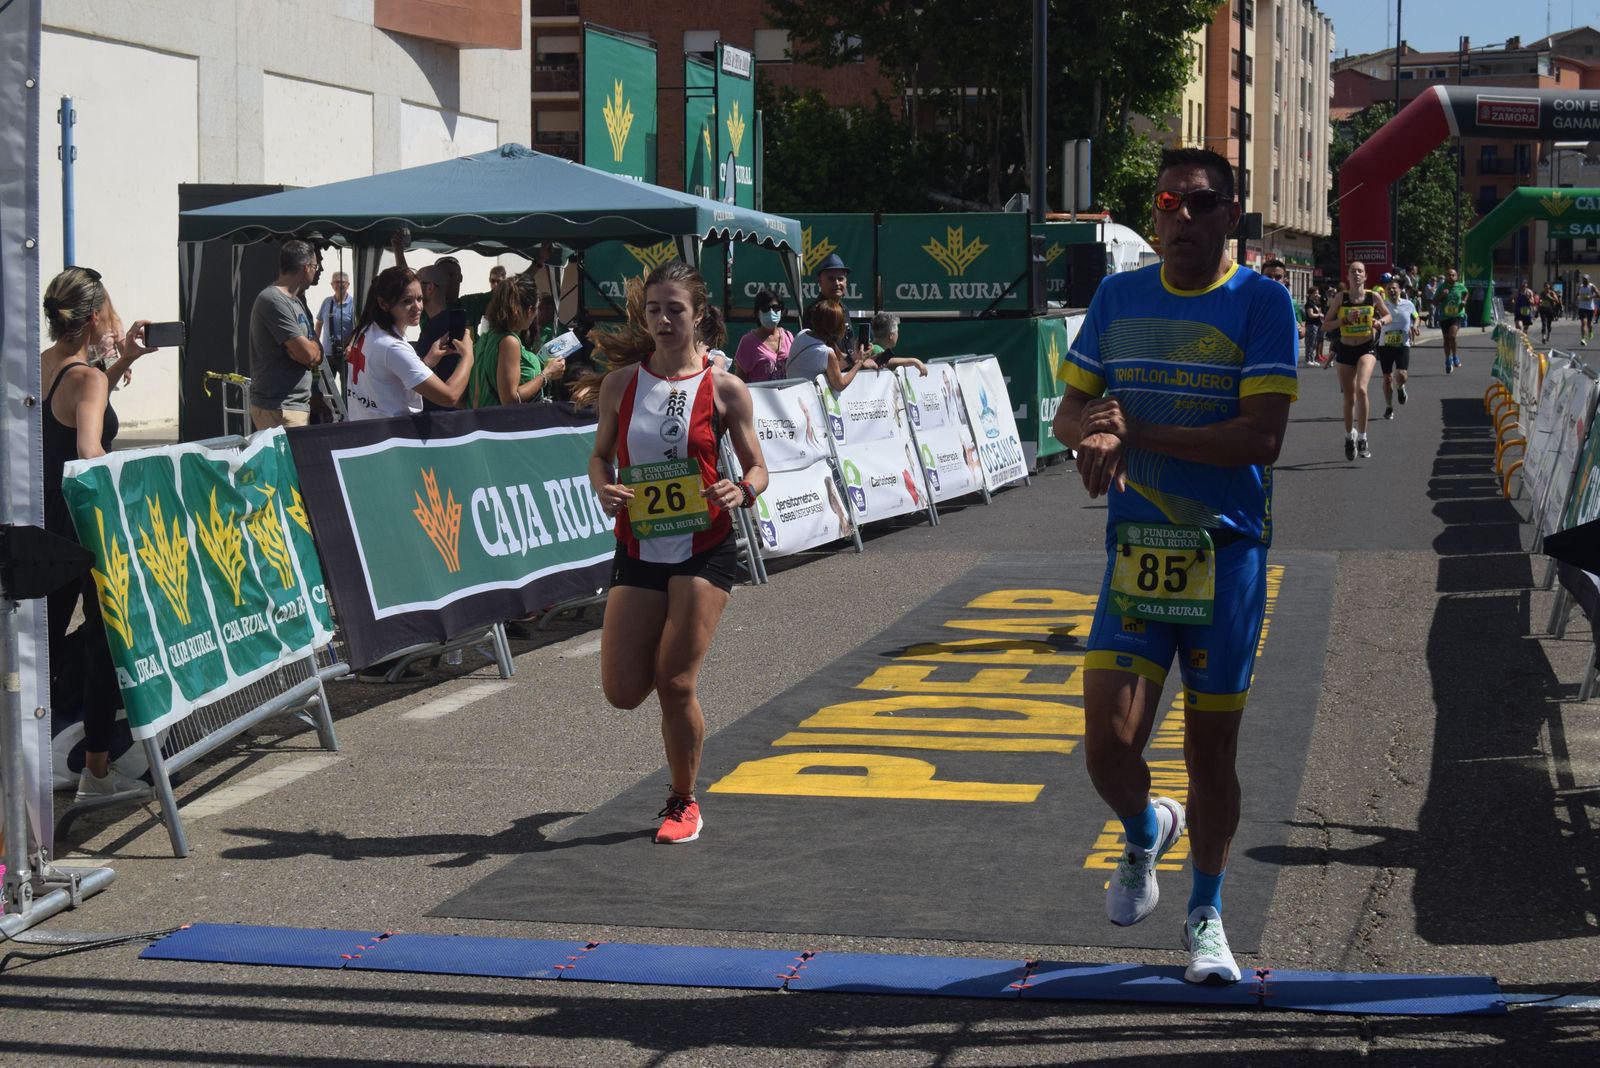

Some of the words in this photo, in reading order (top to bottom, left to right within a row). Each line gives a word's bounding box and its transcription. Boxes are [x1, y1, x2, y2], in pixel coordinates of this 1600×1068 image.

[1553, 99, 1585, 111] CON
[1491, 112, 1536, 122] ZAMORA
[895, 283, 943, 300] CAJA
[948, 282, 1016, 299] RURAL
[980, 435, 1022, 474] OCEANIC
[664, 467, 690, 479] RURAL
[643, 482, 686, 515] 26
[471, 484, 553, 557] CAJA
[653, 522, 675, 533] CAJA
[675, 517, 706, 530] RURAL
[1143, 536, 1166, 547] CAJA
[1167, 538, 1201, 548] RURAL
[1137, 552, 1188, 594] 85
[1136, 603, 1166, 616] CAJA
[1167, 605, 1207, 617] RURAL
[186, 629, 218, 660] RURAL
